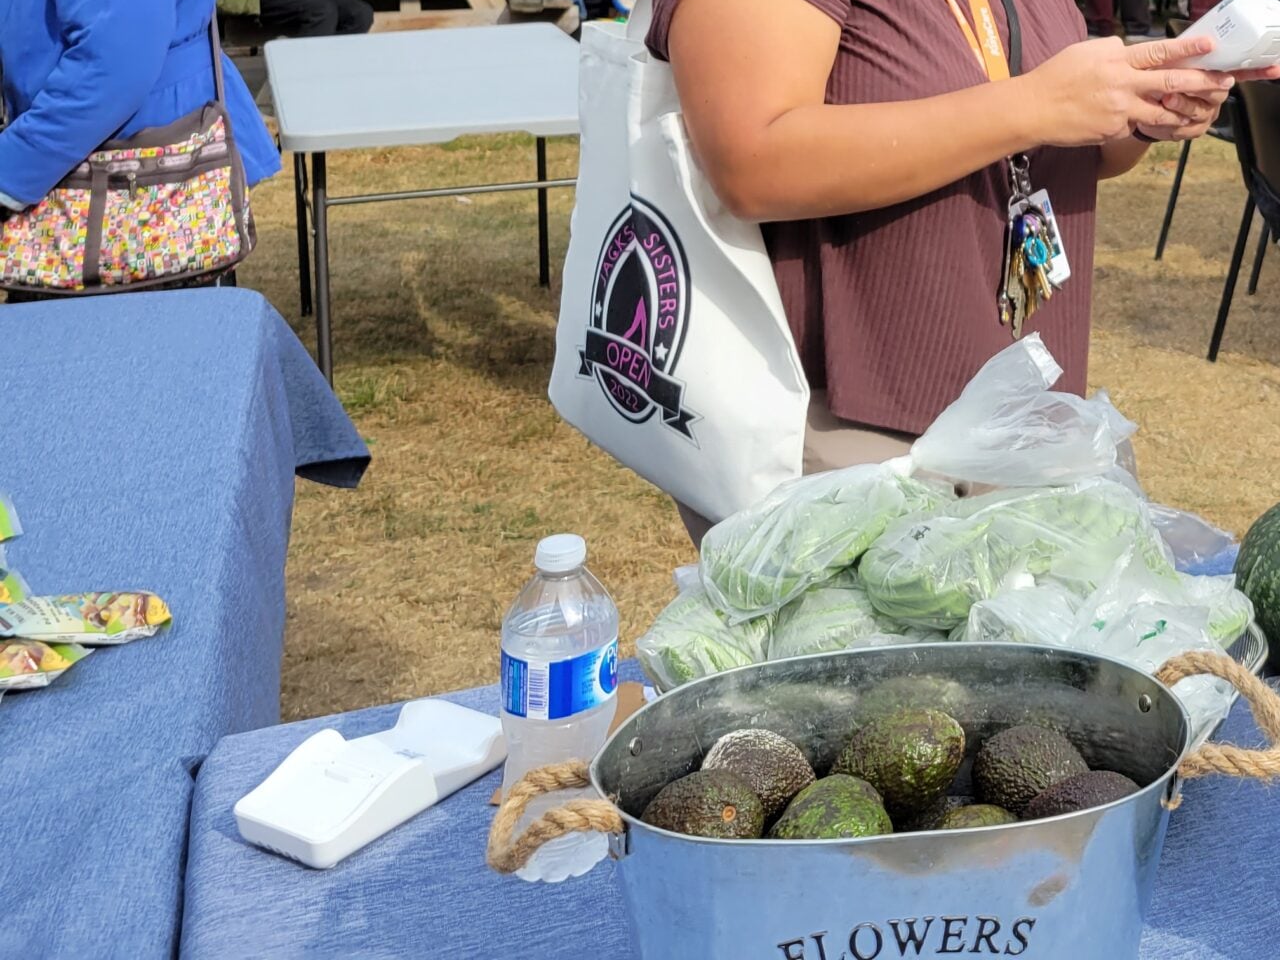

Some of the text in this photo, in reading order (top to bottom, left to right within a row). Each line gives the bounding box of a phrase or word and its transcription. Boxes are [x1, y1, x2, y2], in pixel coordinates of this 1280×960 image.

[643, 232, 677, 331] SISTERS
[606, 342, 652, 390] OPEN
[610, 379, 639, 412] 2022
[776, 915, 1038, 960] FLOWERS
